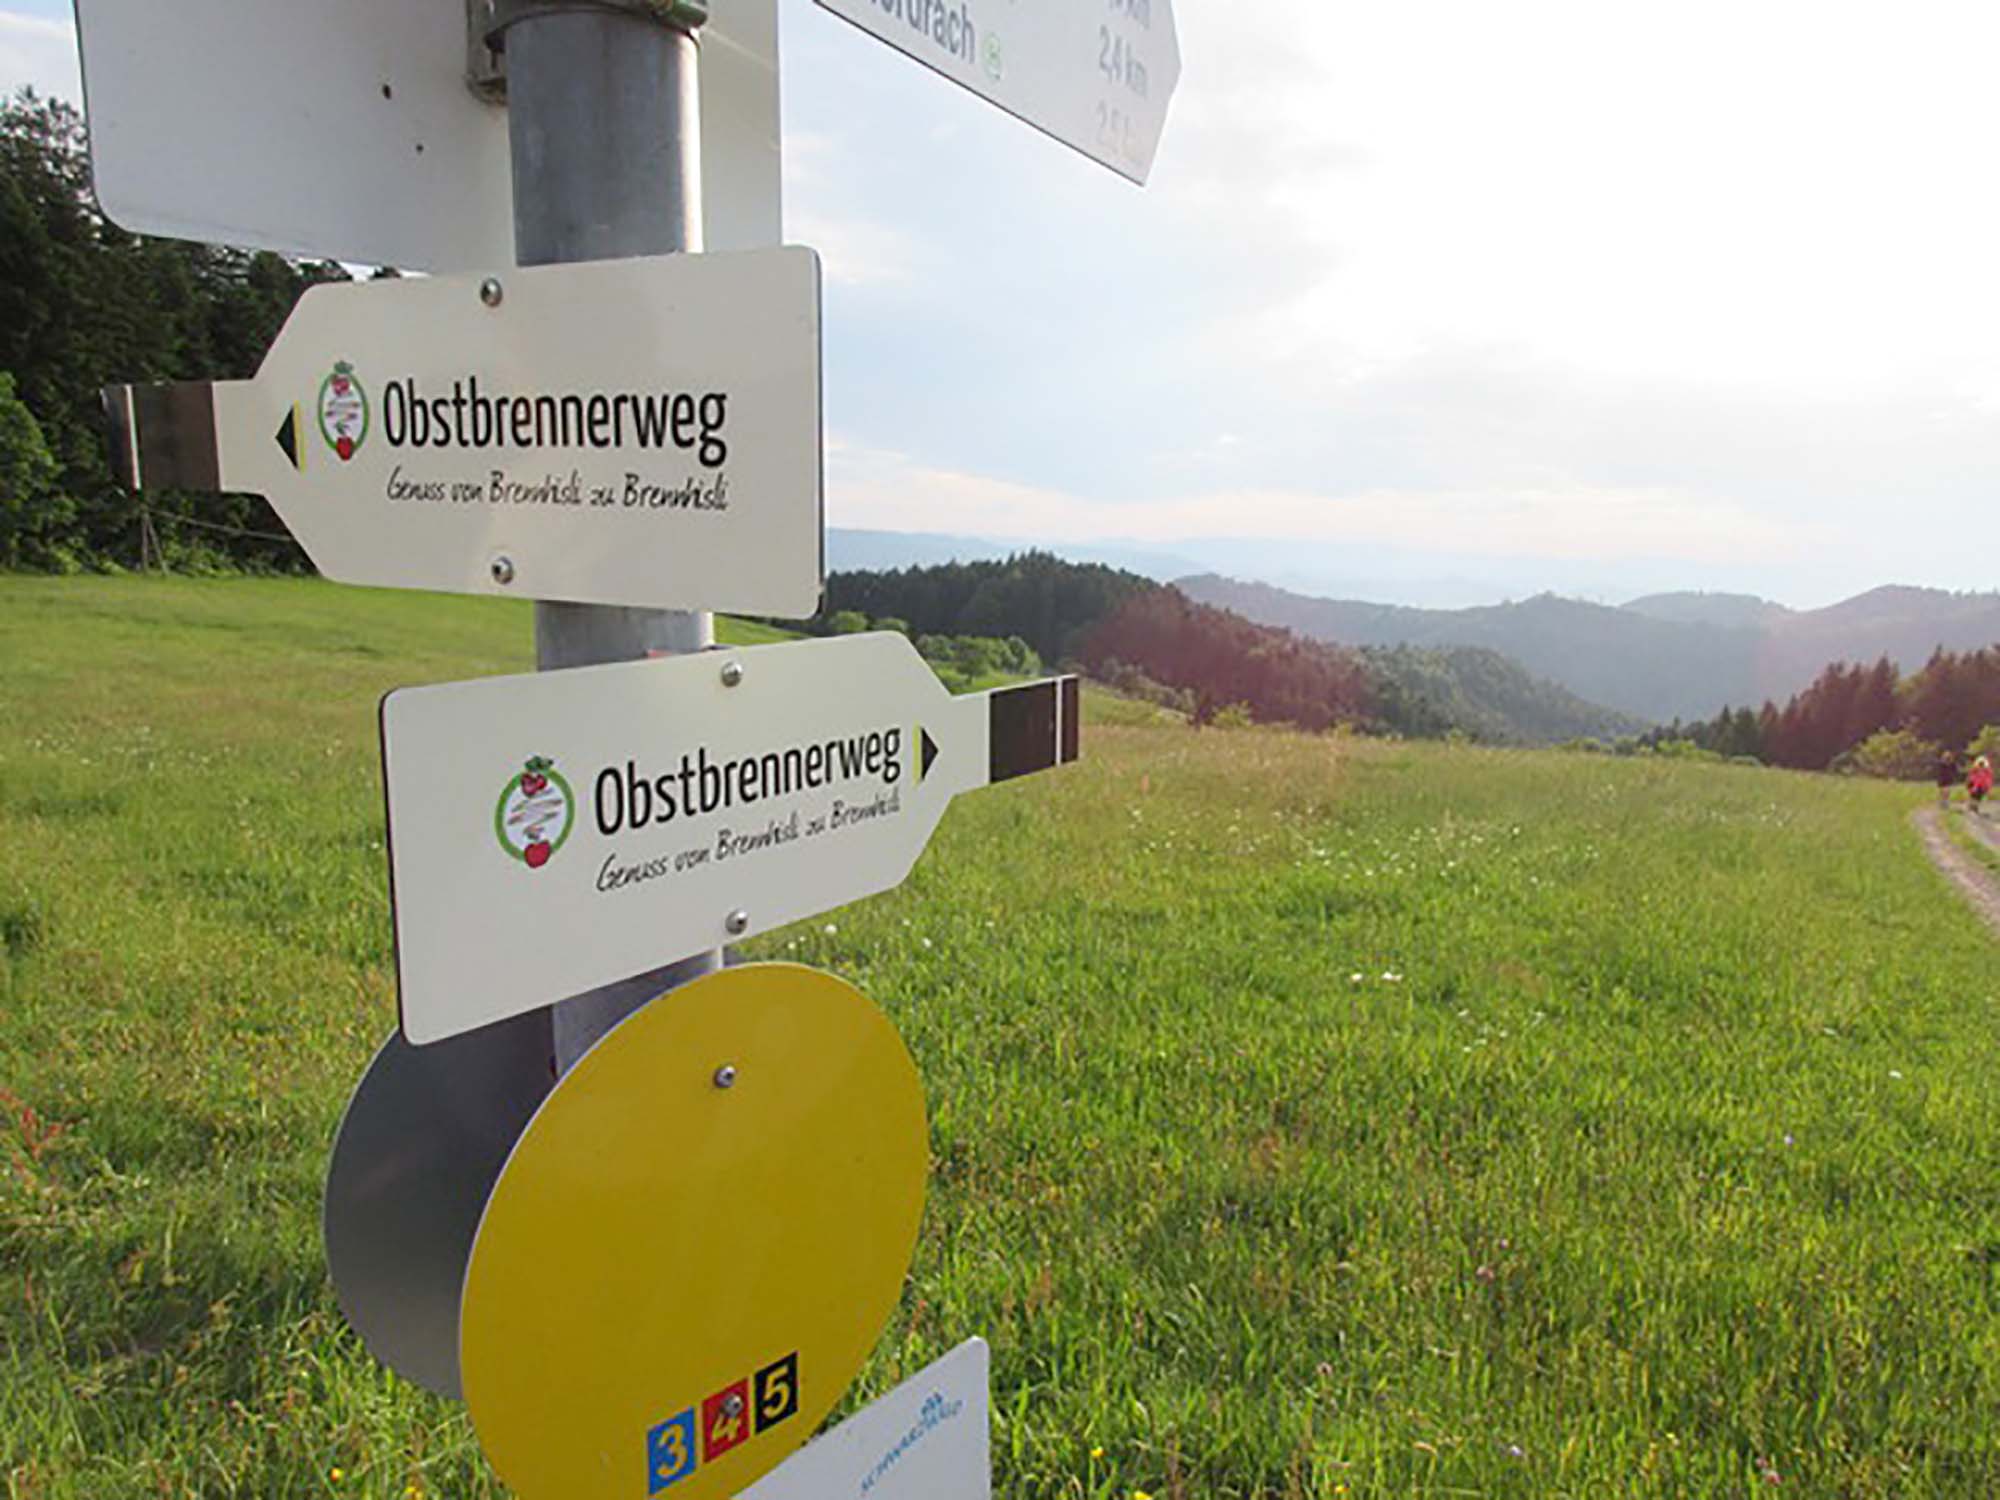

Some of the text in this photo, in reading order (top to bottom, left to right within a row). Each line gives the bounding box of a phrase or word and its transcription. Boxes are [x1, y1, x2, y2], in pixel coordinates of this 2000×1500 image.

[383, 376, 728, 467] Obstbrennerweg
[387, 466, 446, 501] Genuss
[451, 483, 483, 502] von
[590, 486, 616, 507] zu
[594, 728, 901, 834] Obstbrennerweg
[596, 853, 668, 891] Genuss
[674, 848, 711, 872] von
[804, 817, 827, 837] zu
[658, 1366, 790, 1478] 3 4 5
